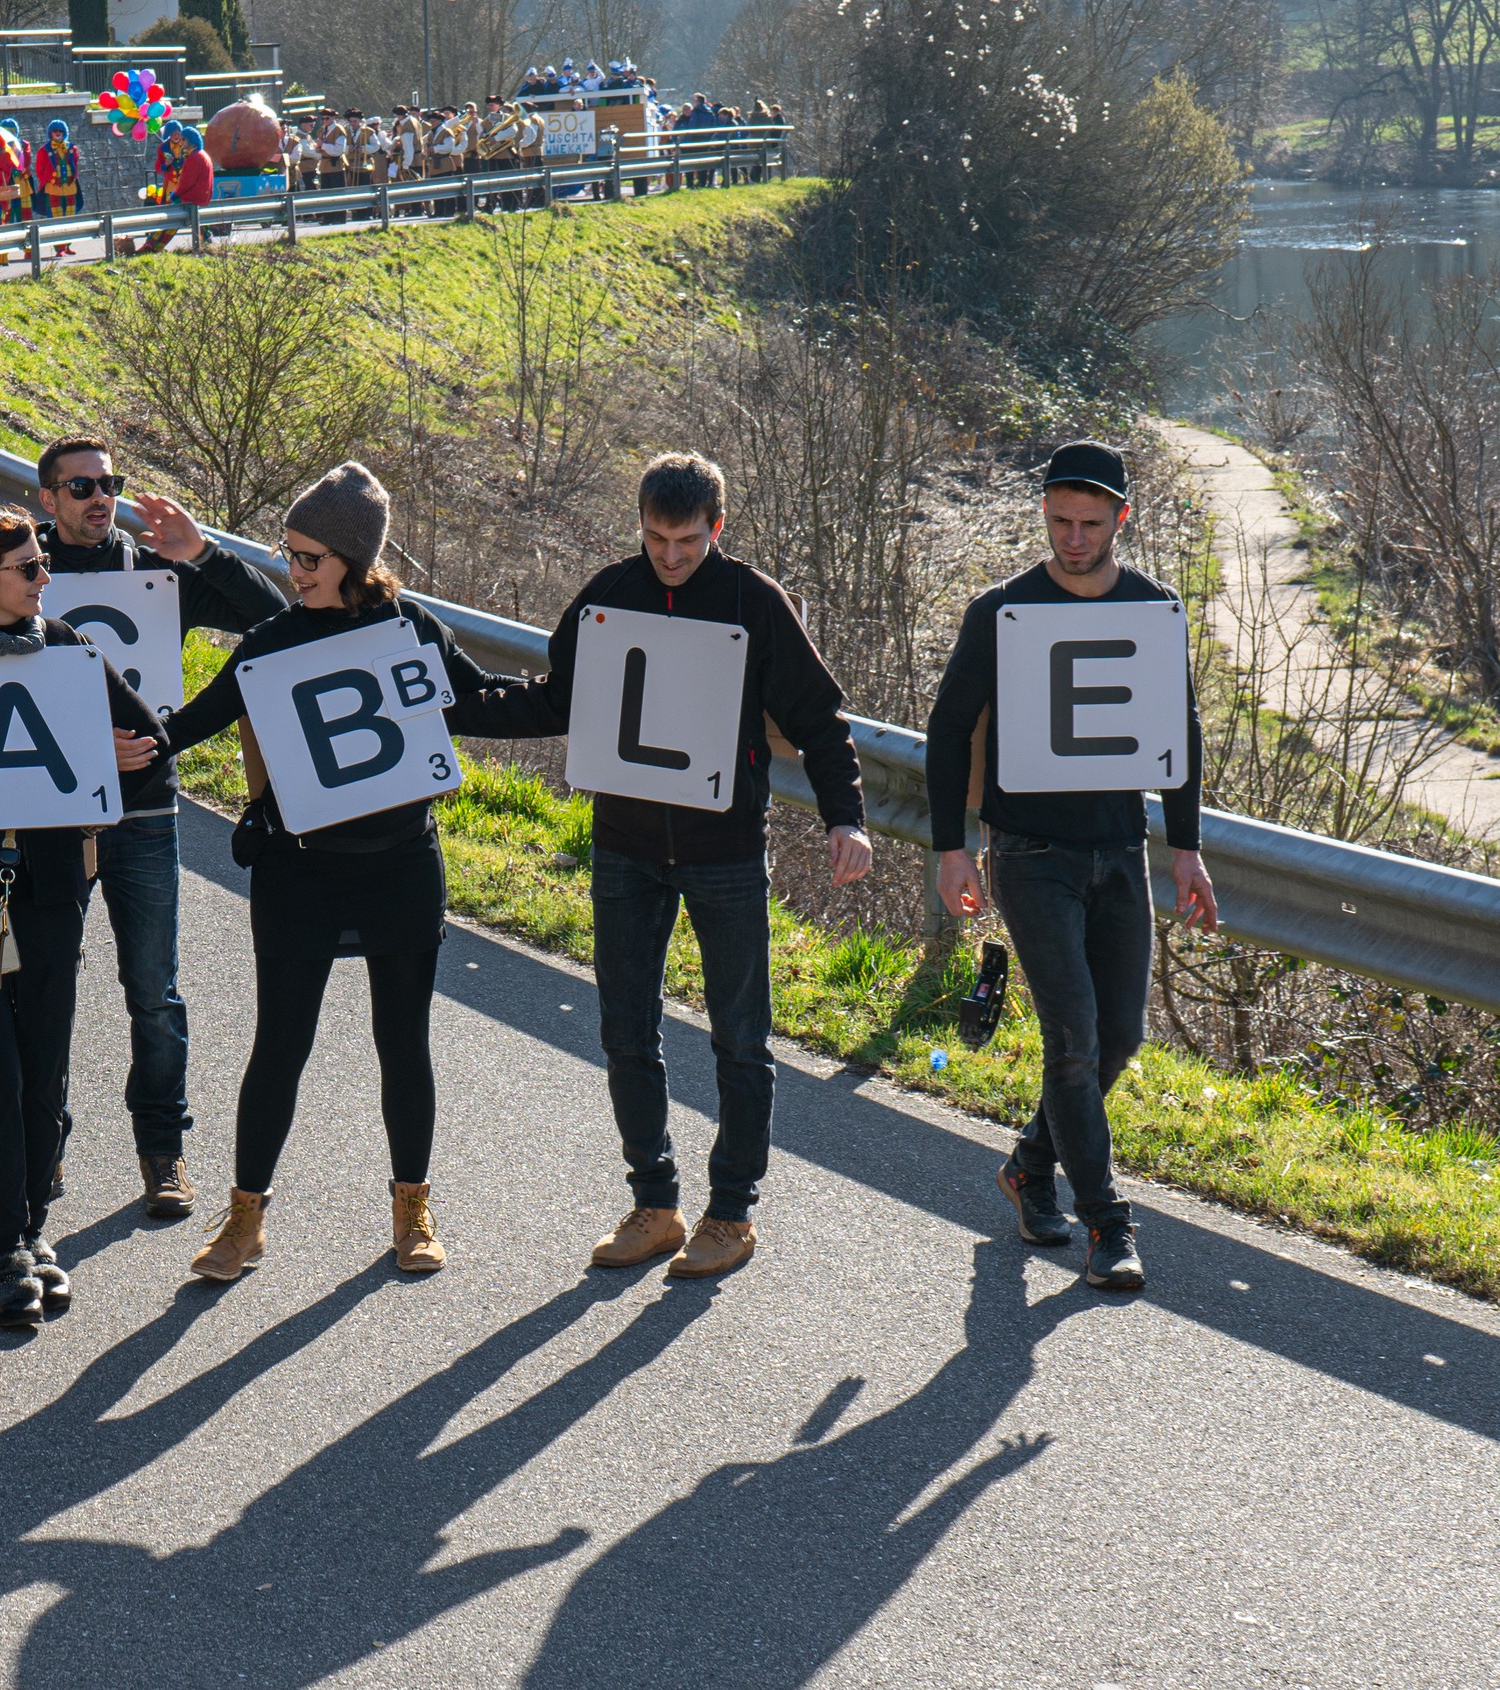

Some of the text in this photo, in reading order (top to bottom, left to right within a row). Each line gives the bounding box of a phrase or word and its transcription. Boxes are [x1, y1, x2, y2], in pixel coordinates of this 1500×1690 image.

[291, 668, 451, 789] B 3
[390, 659, 453, 708] B 3
[618, 646, 721, 799] L 1
[1049, 639, 1172, 777] E 1
[91, 785, 108, 813] 1
